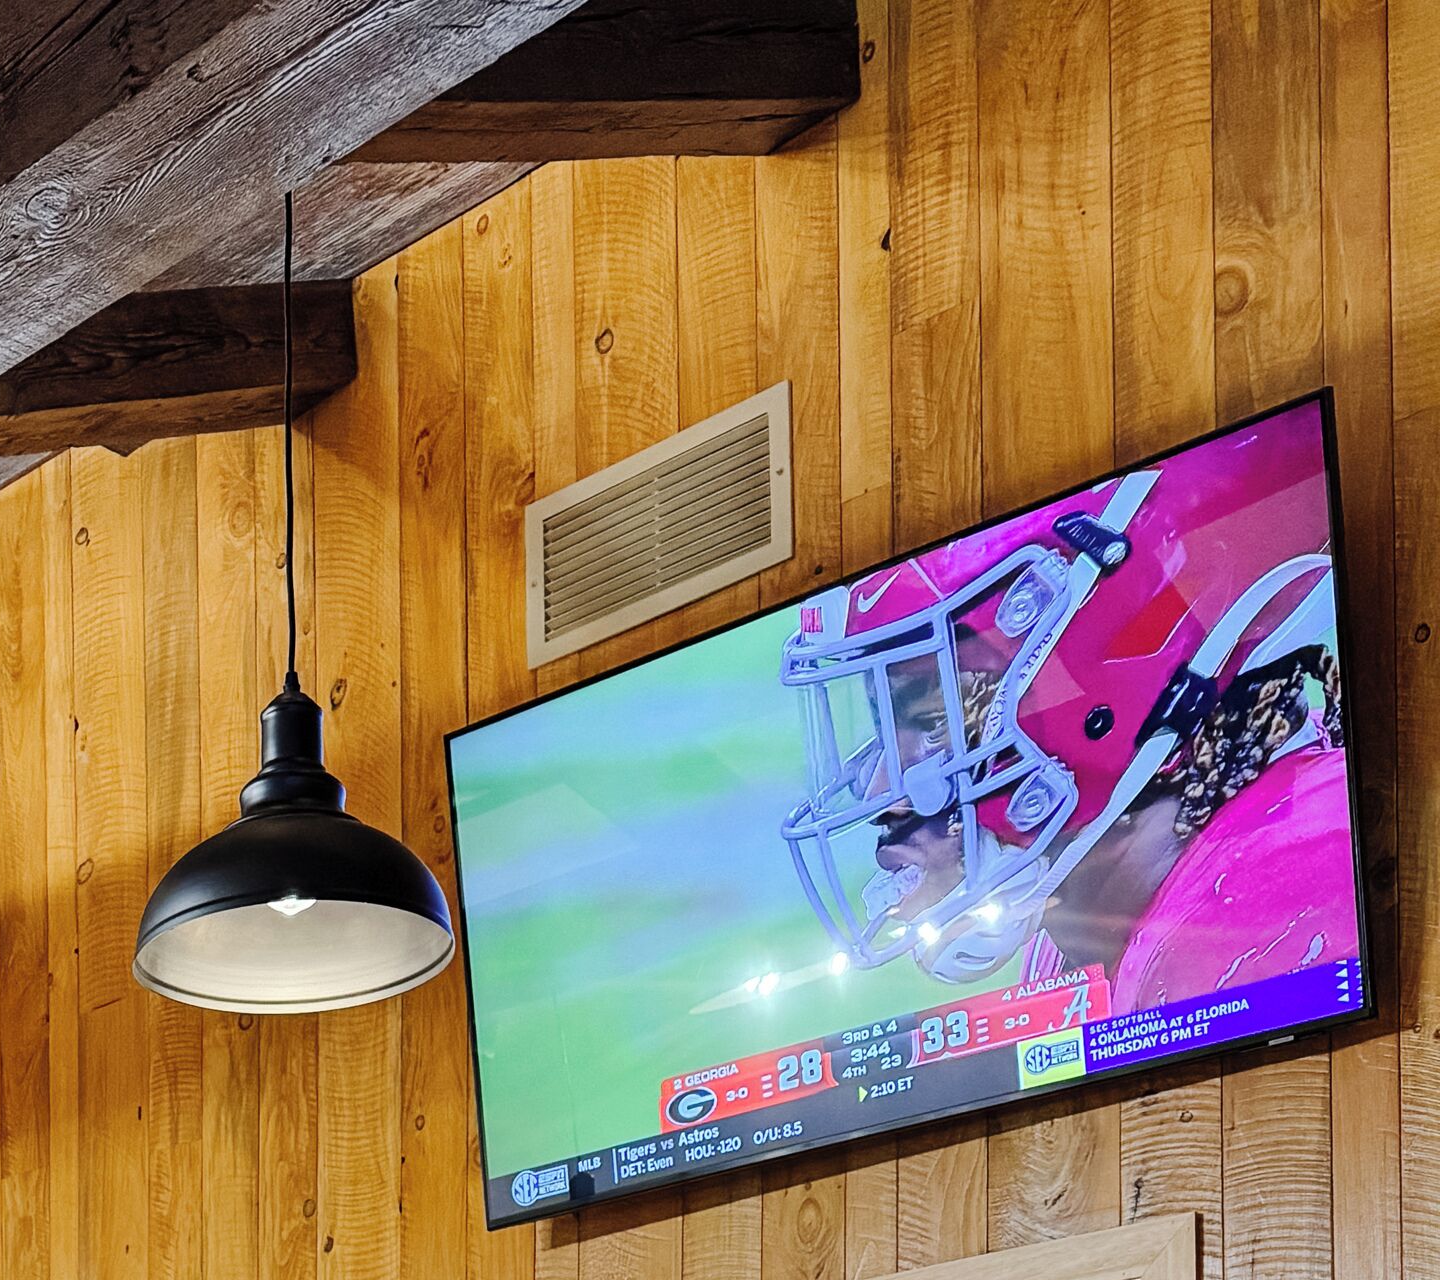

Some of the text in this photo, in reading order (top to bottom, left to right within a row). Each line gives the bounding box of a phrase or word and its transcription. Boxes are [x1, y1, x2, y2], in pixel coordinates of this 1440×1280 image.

[1001, 970, 1090, 1001] 4 ALABAMA
[841, 1019, 898, 1045] 3RD & 4
[921, 1010, 970, 1054] 33
[1090, 1010, 1162, 1035] SEC SOFTBALL
[1090, 998, 1250, 1048] 4 OKLAHOMA AT 6 FLORIDA
[850, 1040, 891, 1063] 3:44
[1090, 1022, 1211, 1062] THURSDAY 6 PM ET
[777, 1049, 823, 1092] 28
[842, 1054, 902, 1079] 4TH 23
[1025, 1044, 1051, 1073] SEC
[673, 1063, 739, 1090] 2 GEORGIA
[870, 1076, 914, 1098] 2:10 ET
[618, 1126, 720, 1161] Tigers vs Astros
[620, 1121, 804, 1178] DET: Even HOU: -120 O/U: 8.5
[578, 1157, 602, 1172] MLB
[514, 1173, 539, 1203] SEC
